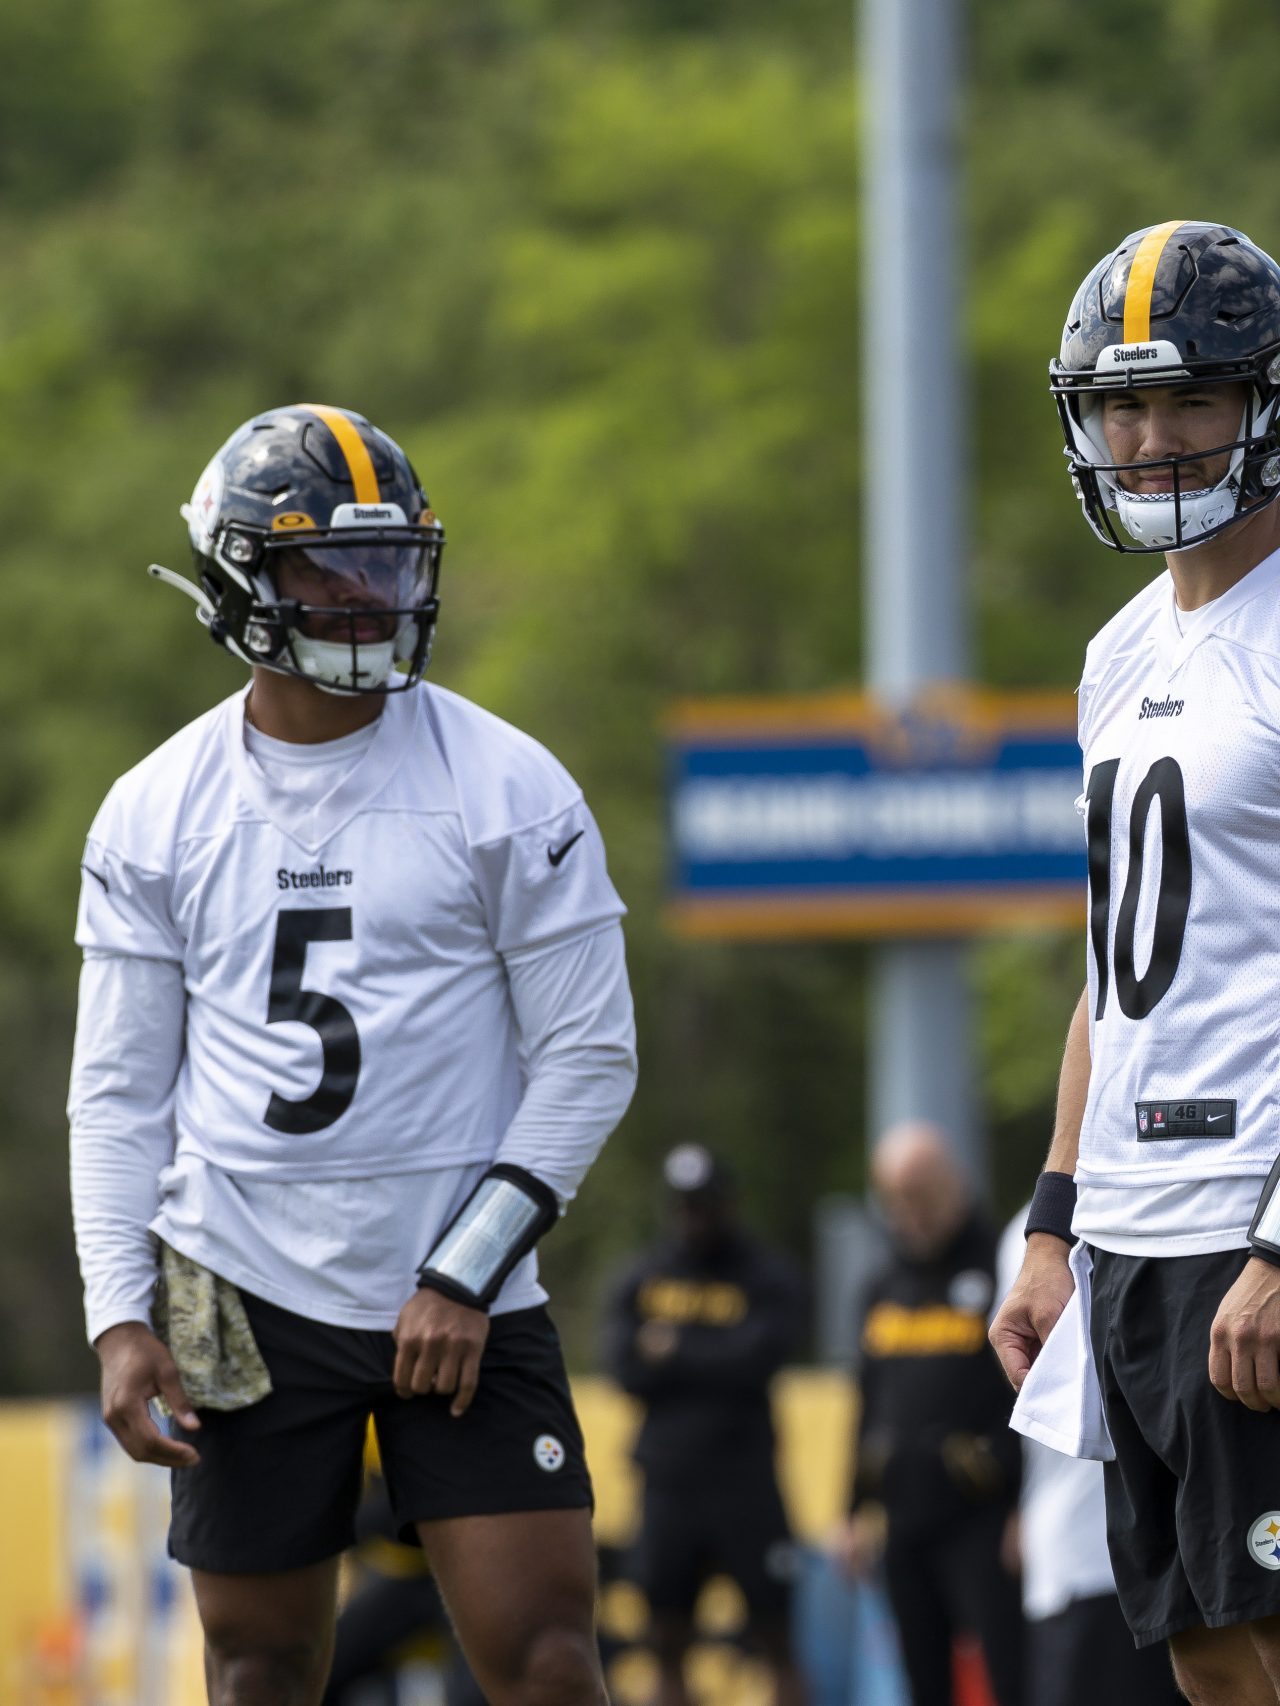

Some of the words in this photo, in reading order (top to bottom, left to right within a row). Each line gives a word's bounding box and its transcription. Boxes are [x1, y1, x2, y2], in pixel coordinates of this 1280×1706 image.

[1114, 346, 1158, 362] Steelers
[353, 507, 392, 519] Steelers
[1138, 694, 1185, 720] Steelers
[277, 864, 353, 890] Steelers
[1084, 756, 1192, 1022] 10
[263, 906, 361, 1135] 5
